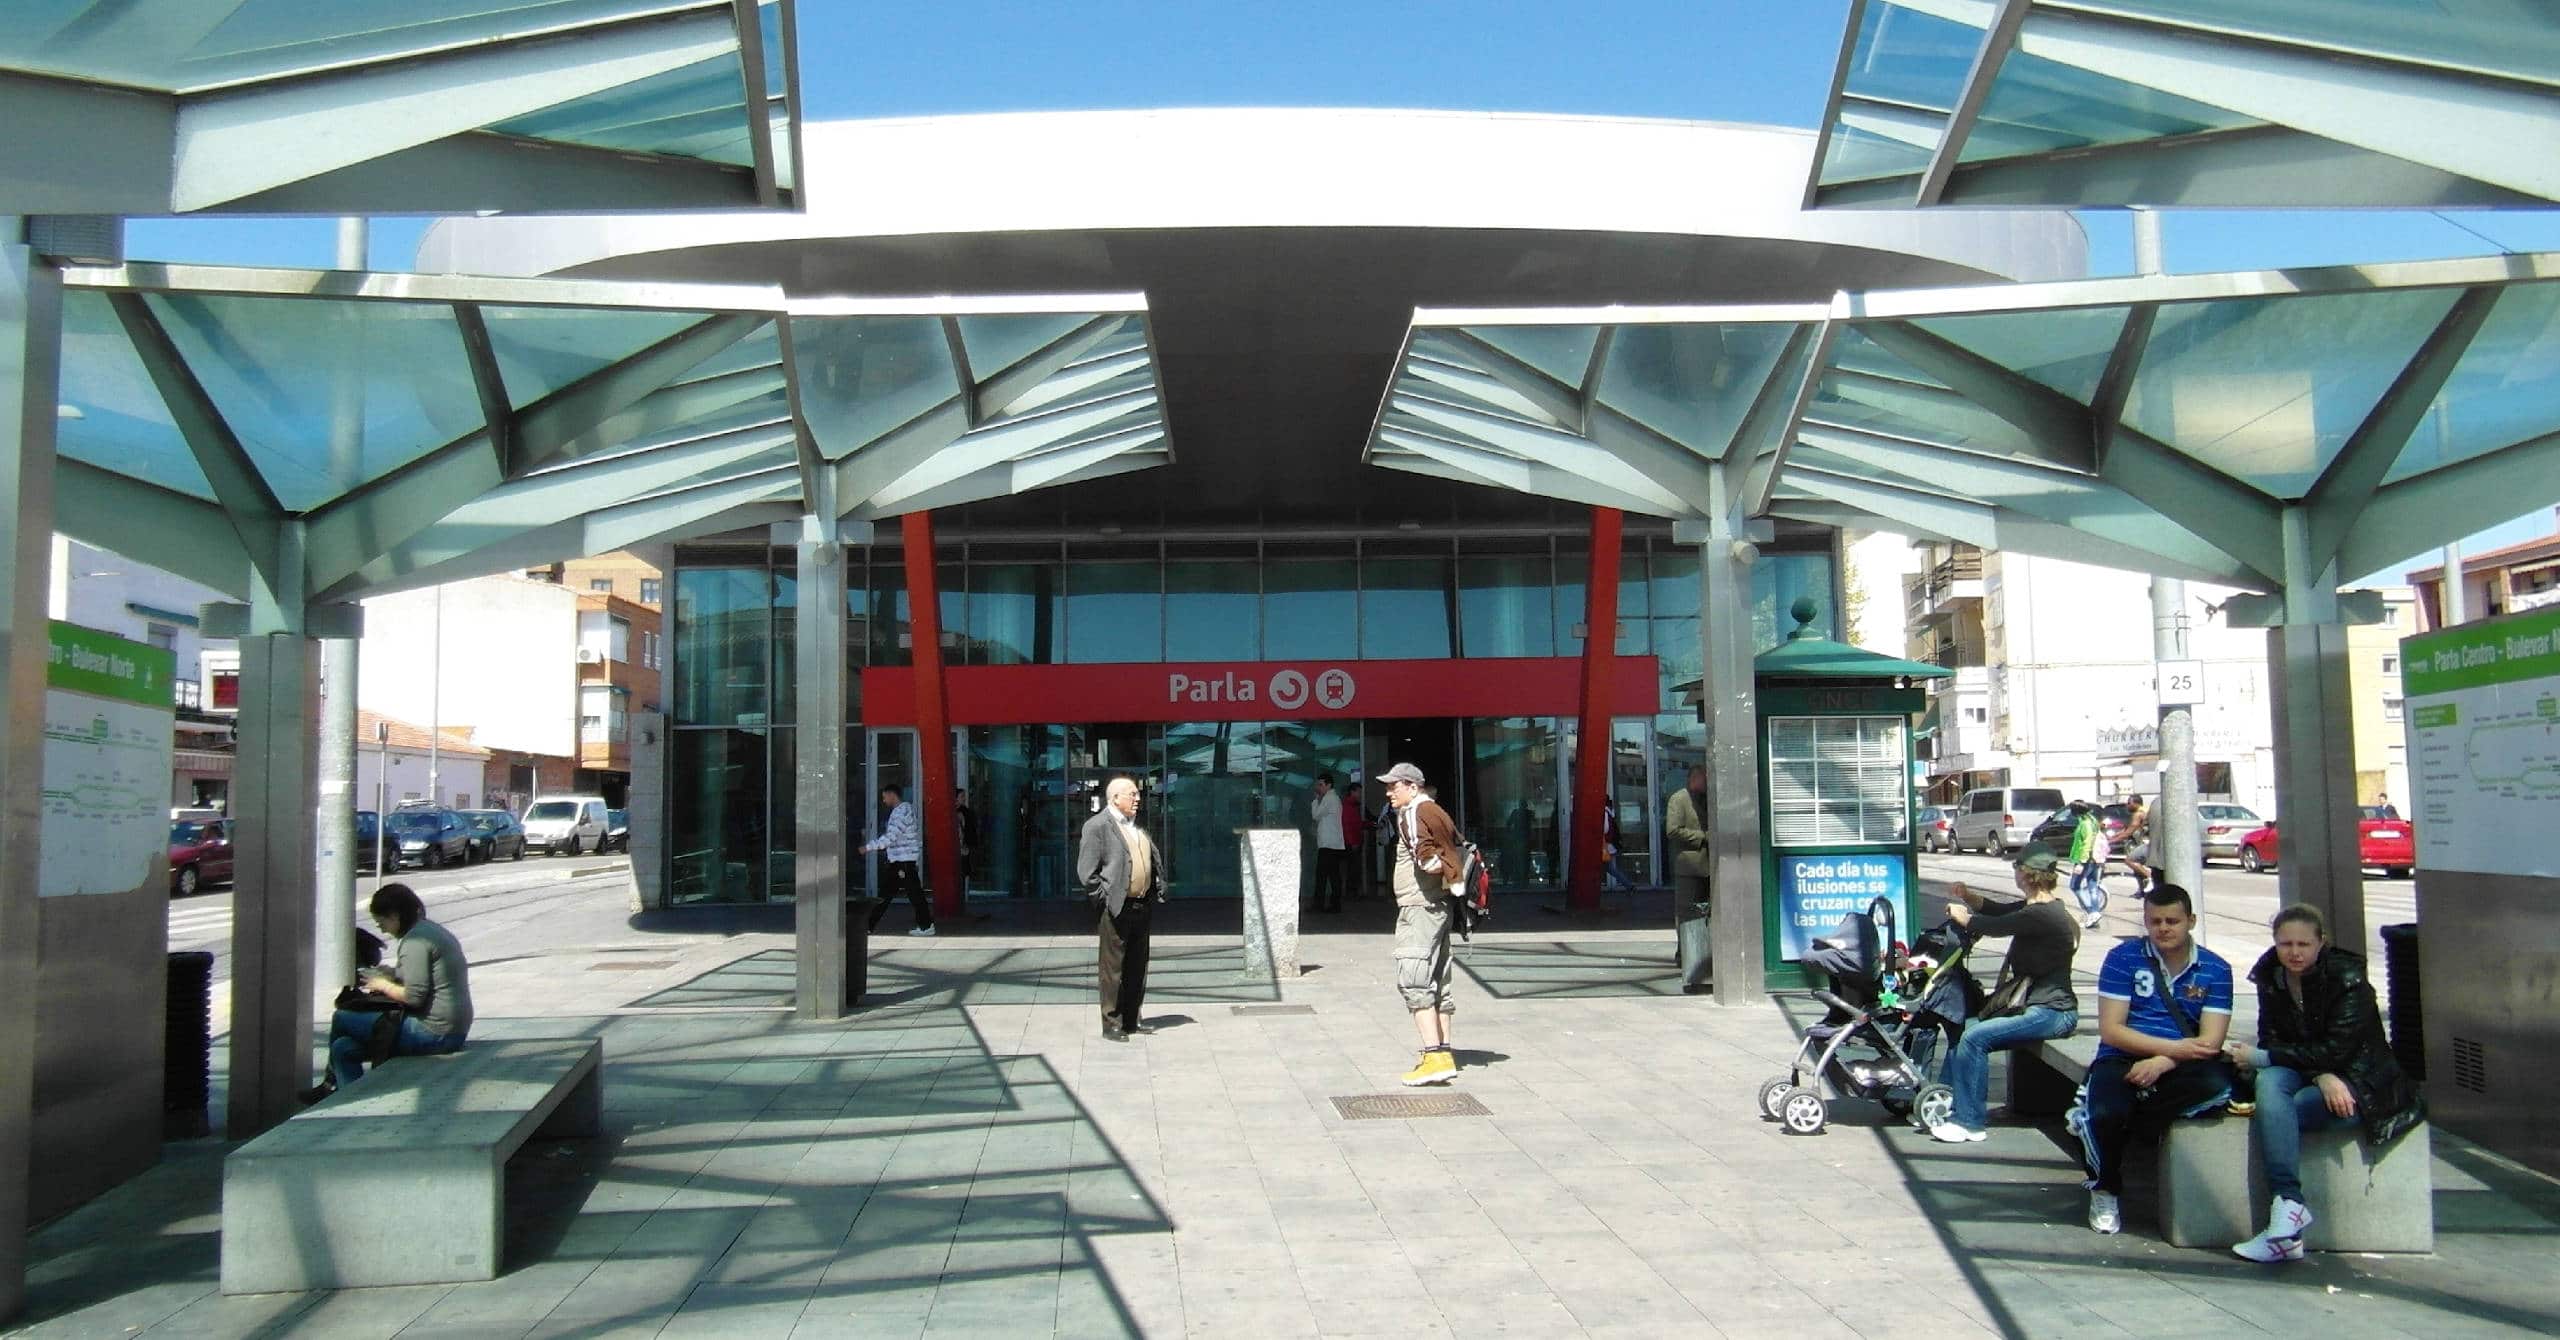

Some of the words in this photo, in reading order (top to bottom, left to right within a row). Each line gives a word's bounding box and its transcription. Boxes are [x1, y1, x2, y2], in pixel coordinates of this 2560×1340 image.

[2434, 650, 2460, 673] Parla
[2461, 645, 2496, 668] Centro
[2505, 635, 2550, 660] Bulevar
[1169, 672, 1256, 702] Parla
[2170, 675, 2192, 690] 25
[1795, 862, 1835, 878] Cada
[1863, 862, 1888, 877] tus
[1797, 878, 1866, 894] ilusiones
[1868, 881, 1887, 893] se
[1801, 897, 1853, 910] cruzan
[1794, 912, 1817, 926] las
[2134, 970, 2155, 998] 3
